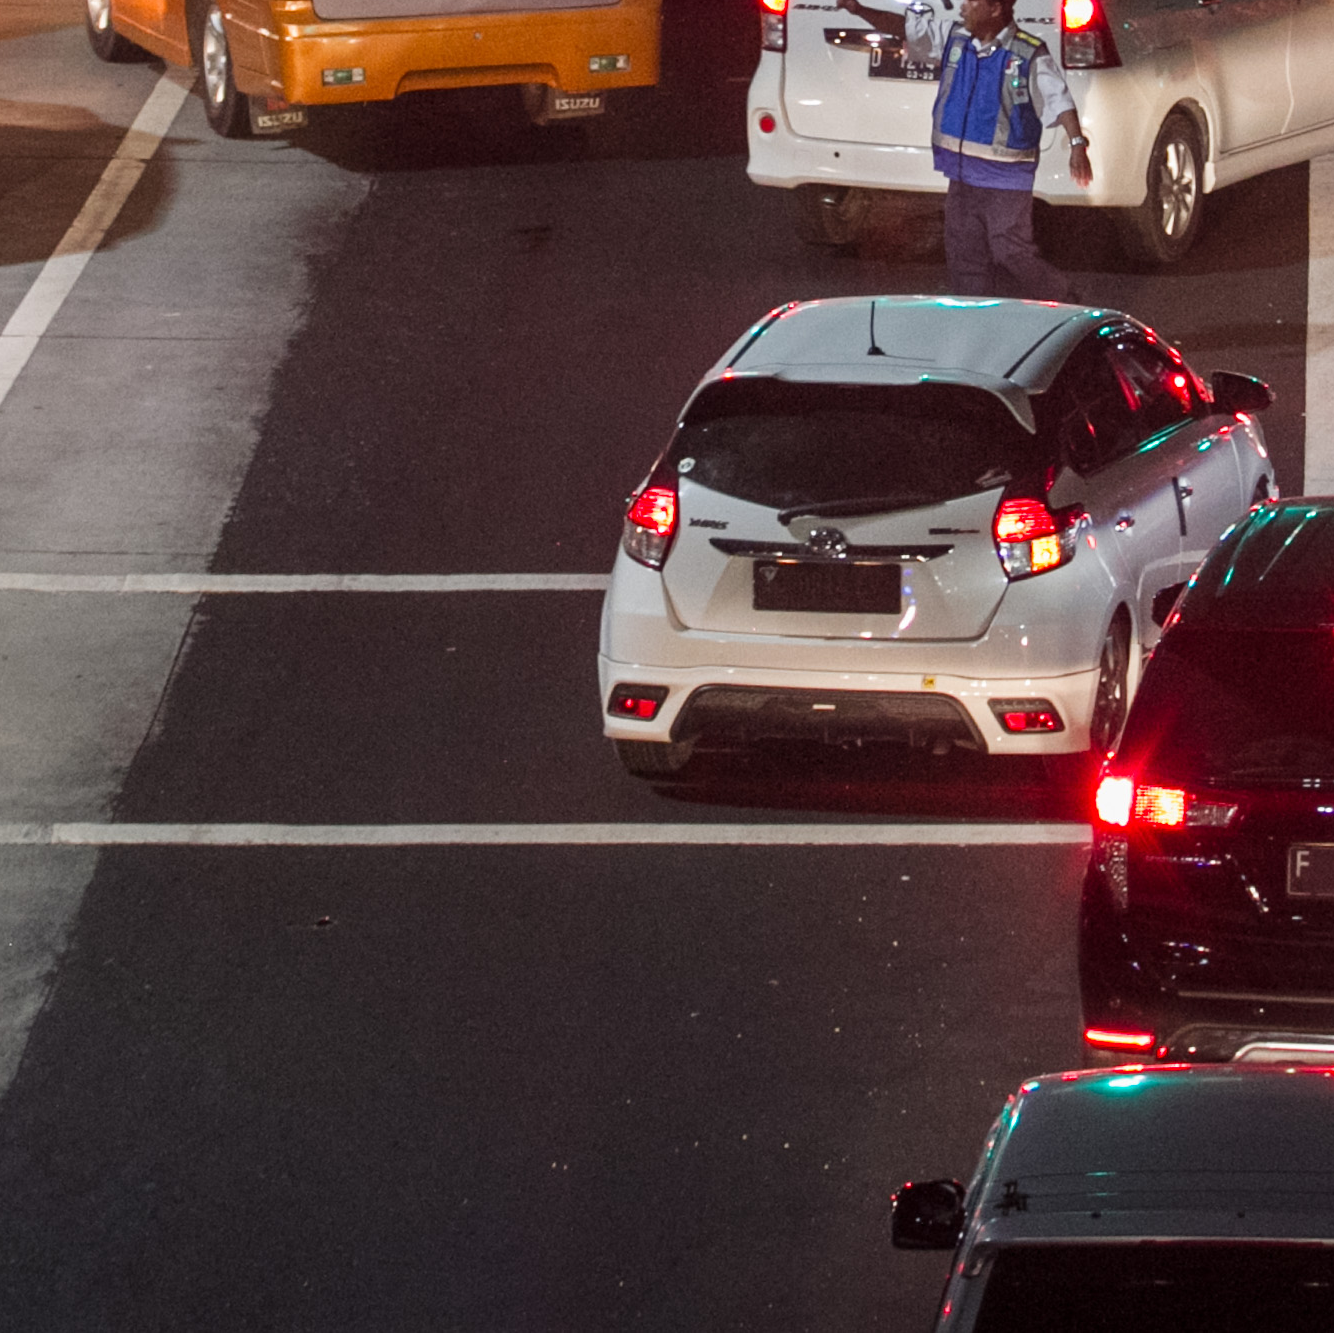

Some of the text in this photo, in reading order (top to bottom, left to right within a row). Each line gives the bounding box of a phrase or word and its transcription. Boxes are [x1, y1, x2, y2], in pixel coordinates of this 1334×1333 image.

[554, 97, 600, 111] ISUZU
[258, 110, 304, 128] ISUZU
[1295, 850, 1310, 877] F
